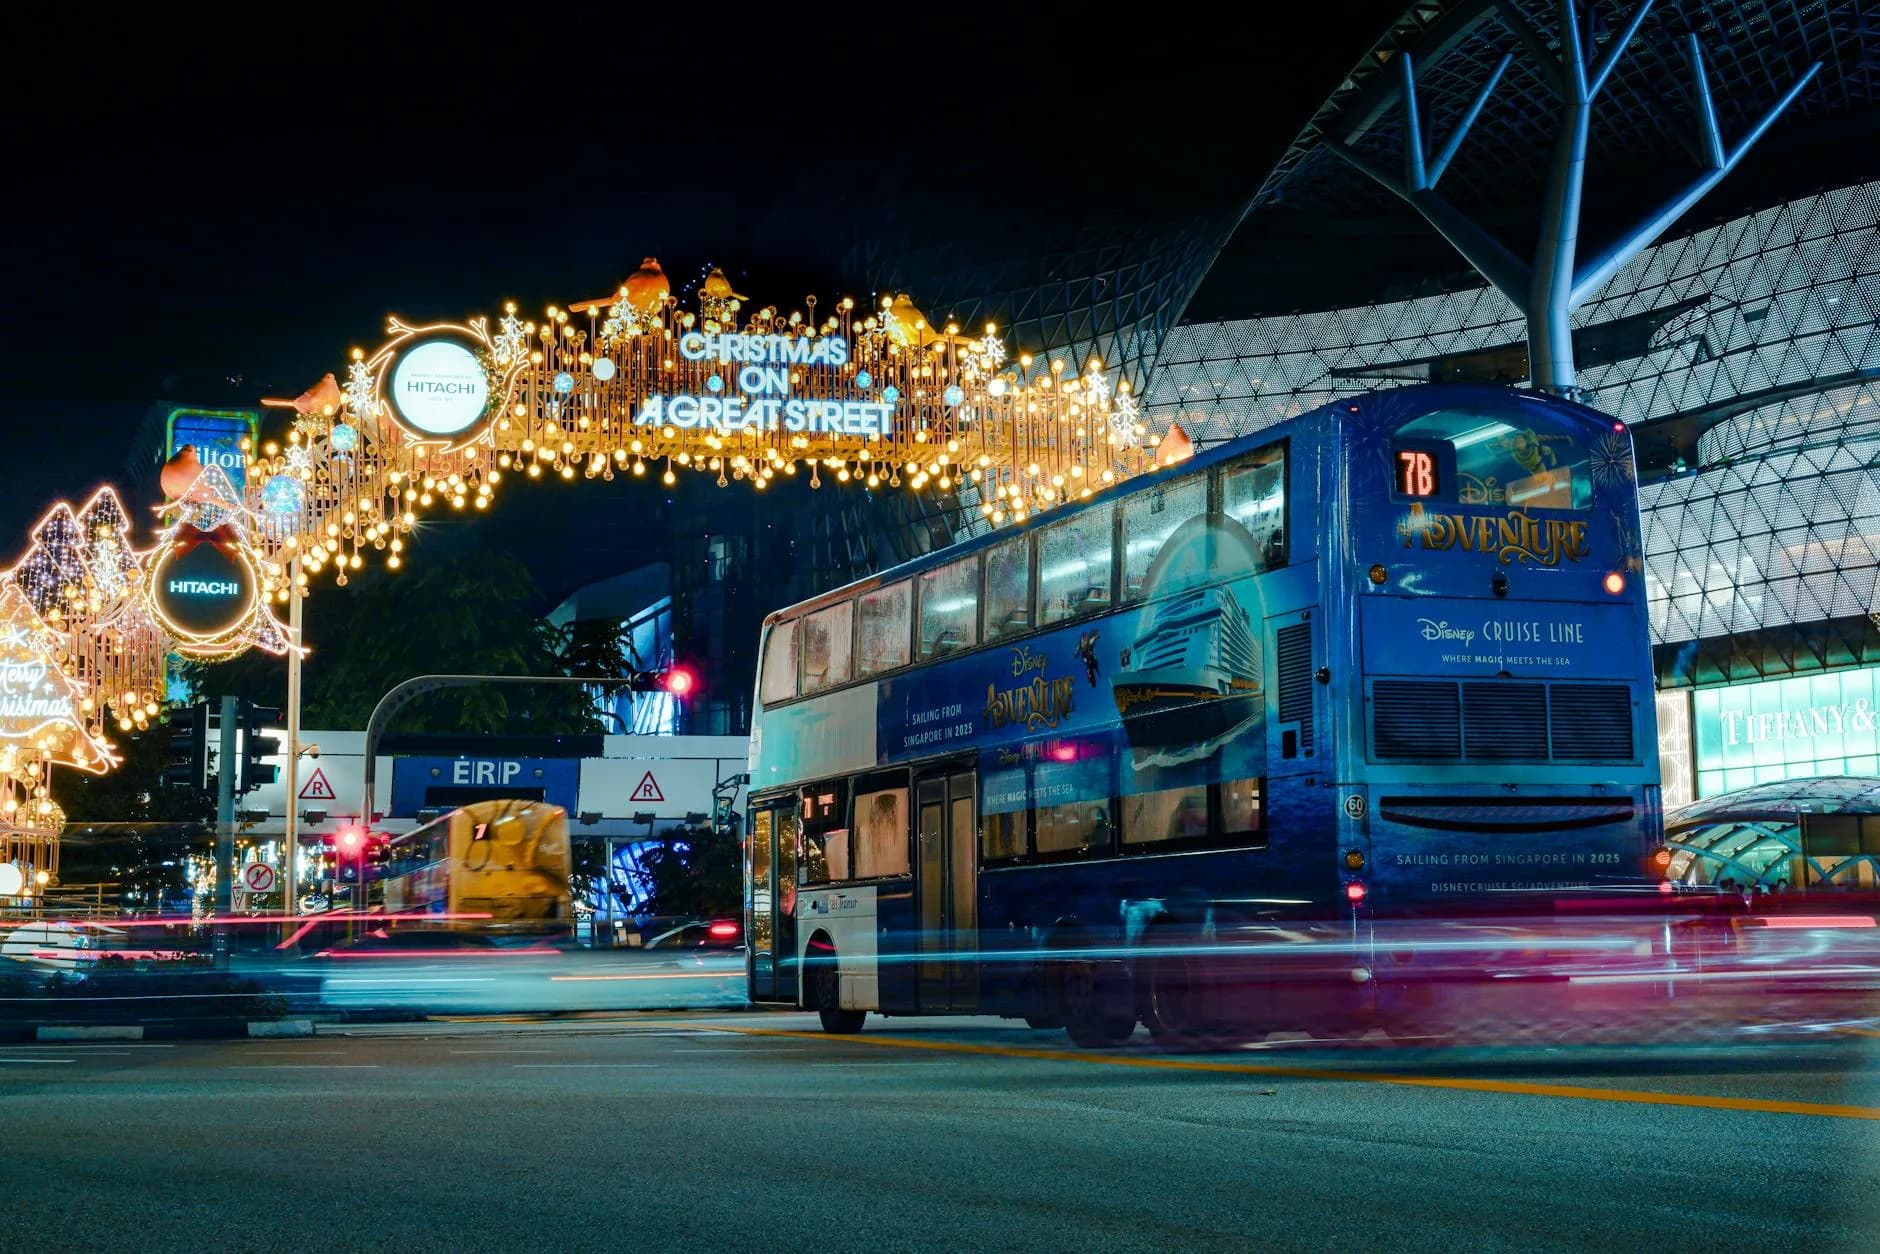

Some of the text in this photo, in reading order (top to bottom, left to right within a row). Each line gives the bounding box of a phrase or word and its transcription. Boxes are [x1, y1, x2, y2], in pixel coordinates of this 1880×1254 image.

[680, 332, 847, 365] CHRISTMAS
[407, 381, 475, 395] HITACHI
[739, 366, 788, 394] ON
[634, 395, 895, 434] A GREAT STREET
[1400, 452, 1433, 496] 7B
[170, 581, 238, 595] HITACHI
[1417, 618, 1584, 647] Disney CRUISE LINE
[1442, 654, 1570, 665] WHERE MAGIC MEETS THE SEA
[912, 703, 962, 726] SAILING FROM
[1720, 697, 1880, 745] TIFFANY &
[903, 722, 973, 748] SINGAPORE IN 2025
[312, 781, 324, 795] R
[643, 783, 654, 797] R
[1007, 789, 1027, 801] MAGIC
[1049, 784, 1061, 797] THE
[1062, 783, 1074, 794] SEA
[1348, 799, 1364, 811] 60
[1396, 852, 1621, 866] SAILING FROM SINGAPORE IN 2025
